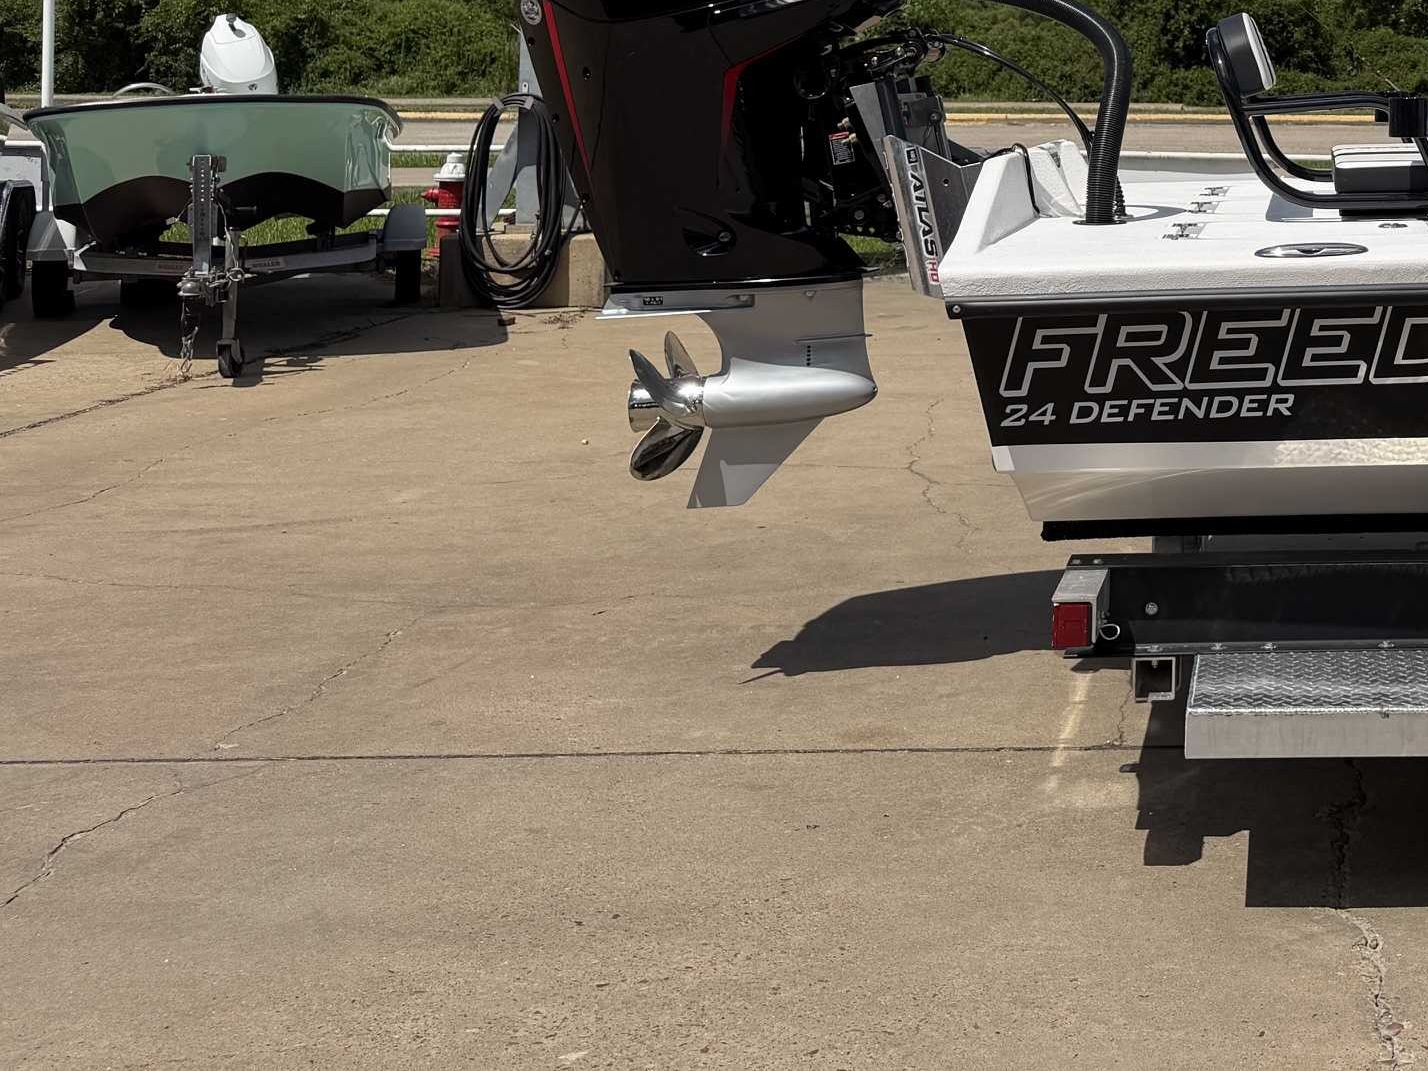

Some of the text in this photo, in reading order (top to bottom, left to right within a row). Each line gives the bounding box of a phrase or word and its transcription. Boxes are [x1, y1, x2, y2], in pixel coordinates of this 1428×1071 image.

[908, 171, 939, 258] ATLAS
[927, 257, 941, 284] HD
[999, 392, 1296, 428] 24 DEFENDER
